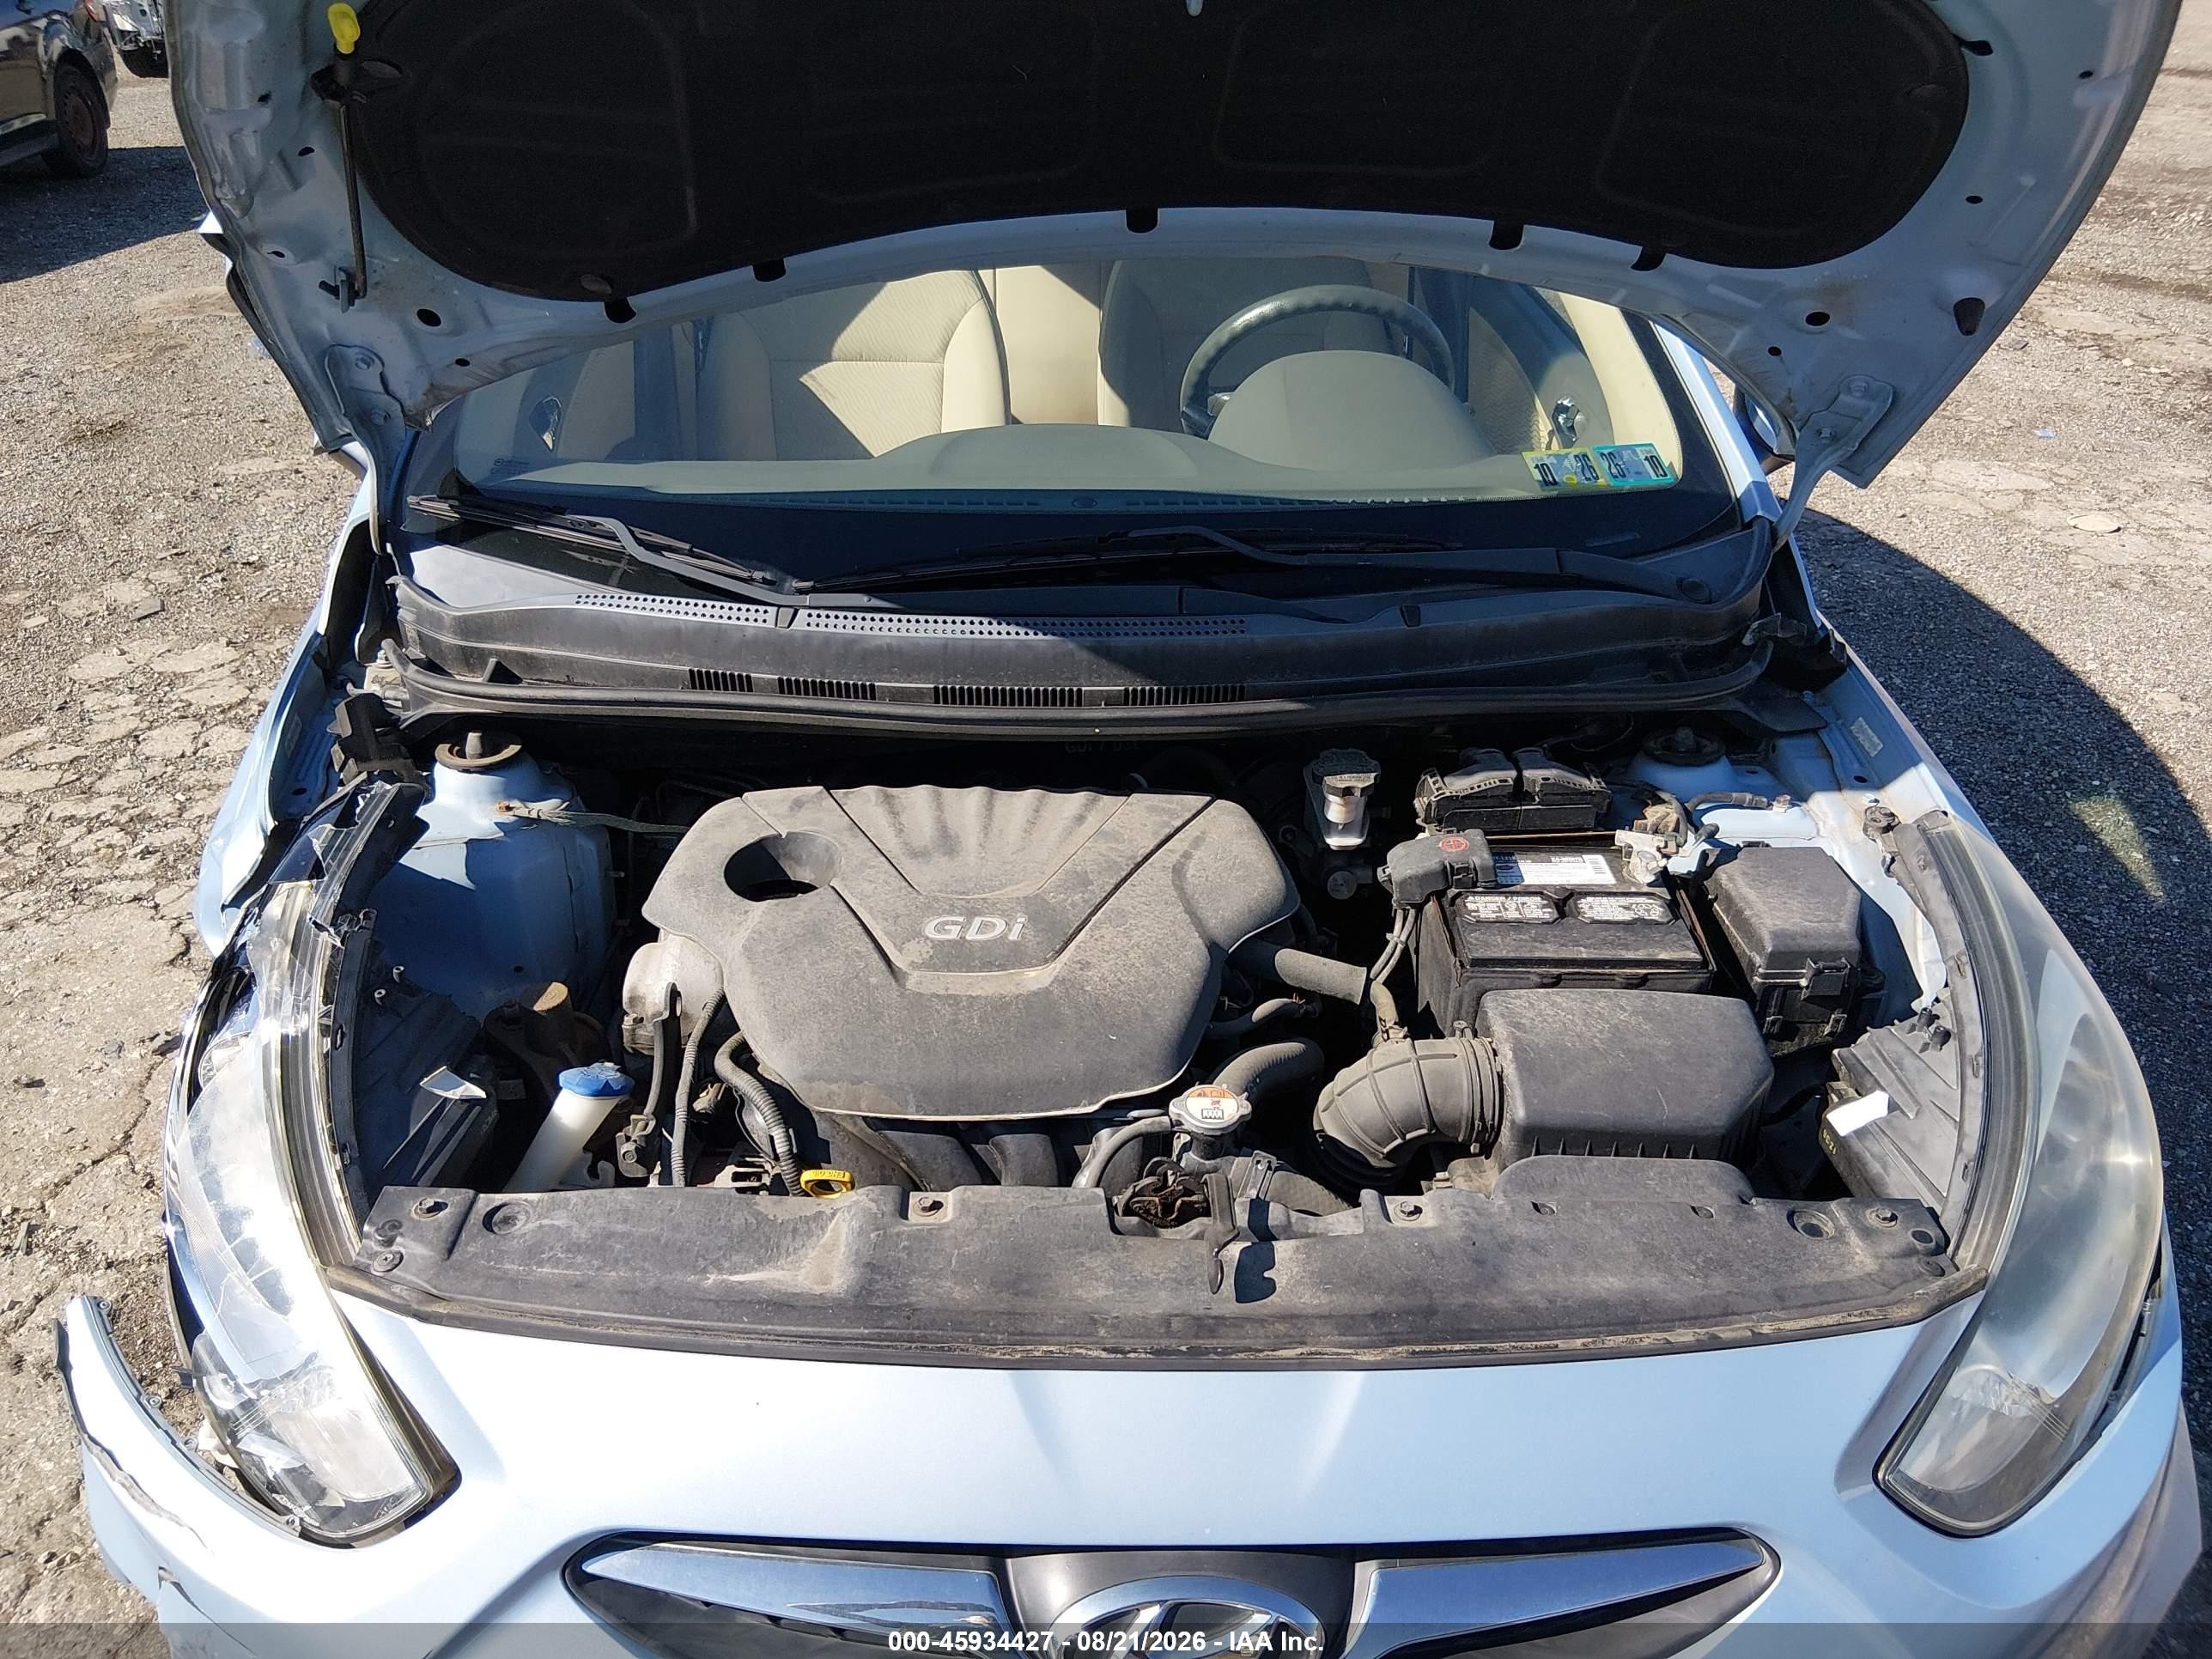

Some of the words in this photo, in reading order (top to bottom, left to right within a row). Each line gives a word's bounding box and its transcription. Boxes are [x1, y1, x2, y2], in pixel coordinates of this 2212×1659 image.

[1534, 463, 1559, 486] 10
[1574, 453, 1600, 482] 26
[1601, 452, 1626, 479] 26
[1644, 455, 1668, 478] 10
[924, 915, 1027, 941] GDi
